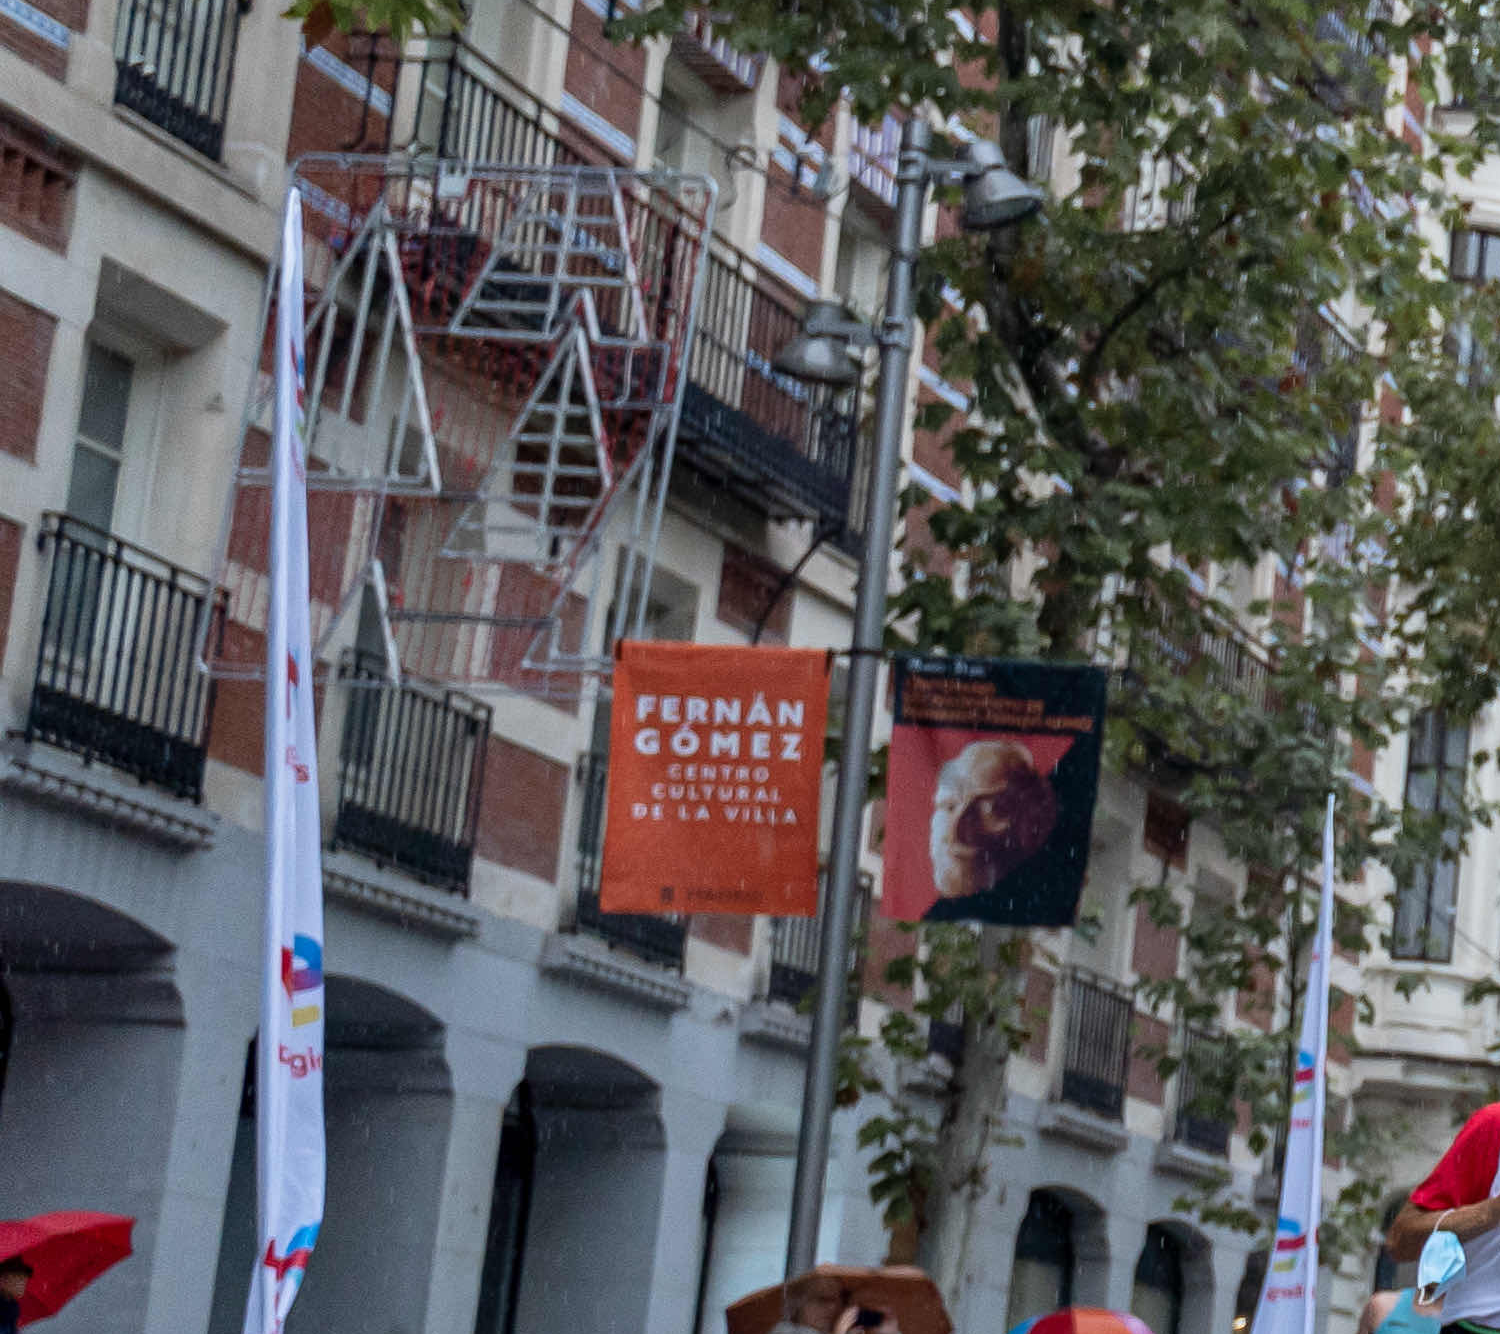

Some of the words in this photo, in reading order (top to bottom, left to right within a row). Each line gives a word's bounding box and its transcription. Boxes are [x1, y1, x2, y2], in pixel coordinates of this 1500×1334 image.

[635, 691, 805, 727] FERNÁN
[634, 722, 802, 761] GÓMEZ
[668, 763, 770, 783] CENTRO
[652, 783, 782, 803] CULTURAL
[631, 802, 664, 821] DE
[677, 804, 710, 821] LA
[724, 806, 798, 825] VILLA
